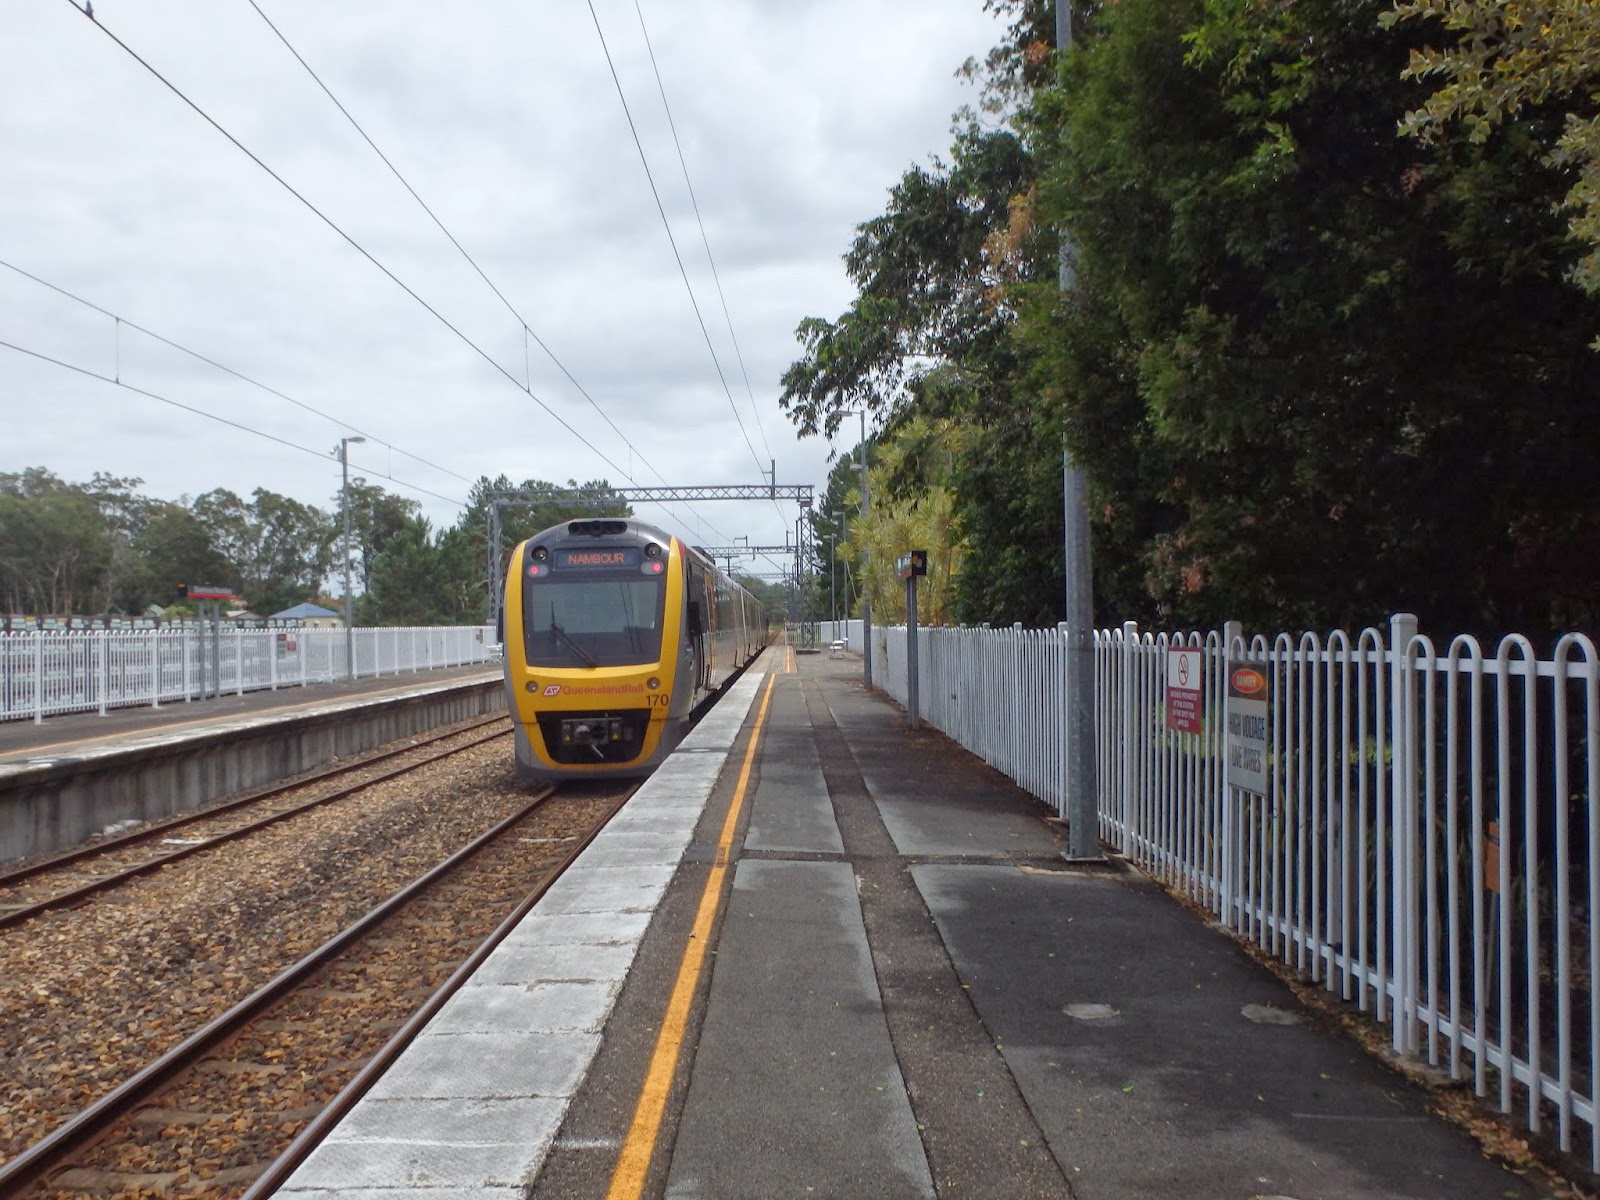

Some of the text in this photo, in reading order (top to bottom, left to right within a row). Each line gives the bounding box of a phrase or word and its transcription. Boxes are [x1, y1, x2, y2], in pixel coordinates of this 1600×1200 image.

[568, 553, 625, 565] NAMBOUR
[646, 694, 669, 706] 170
[1243, 714, 1265, 741] VOLTAGE
[1243, 746, 1261, 774] WIRES
